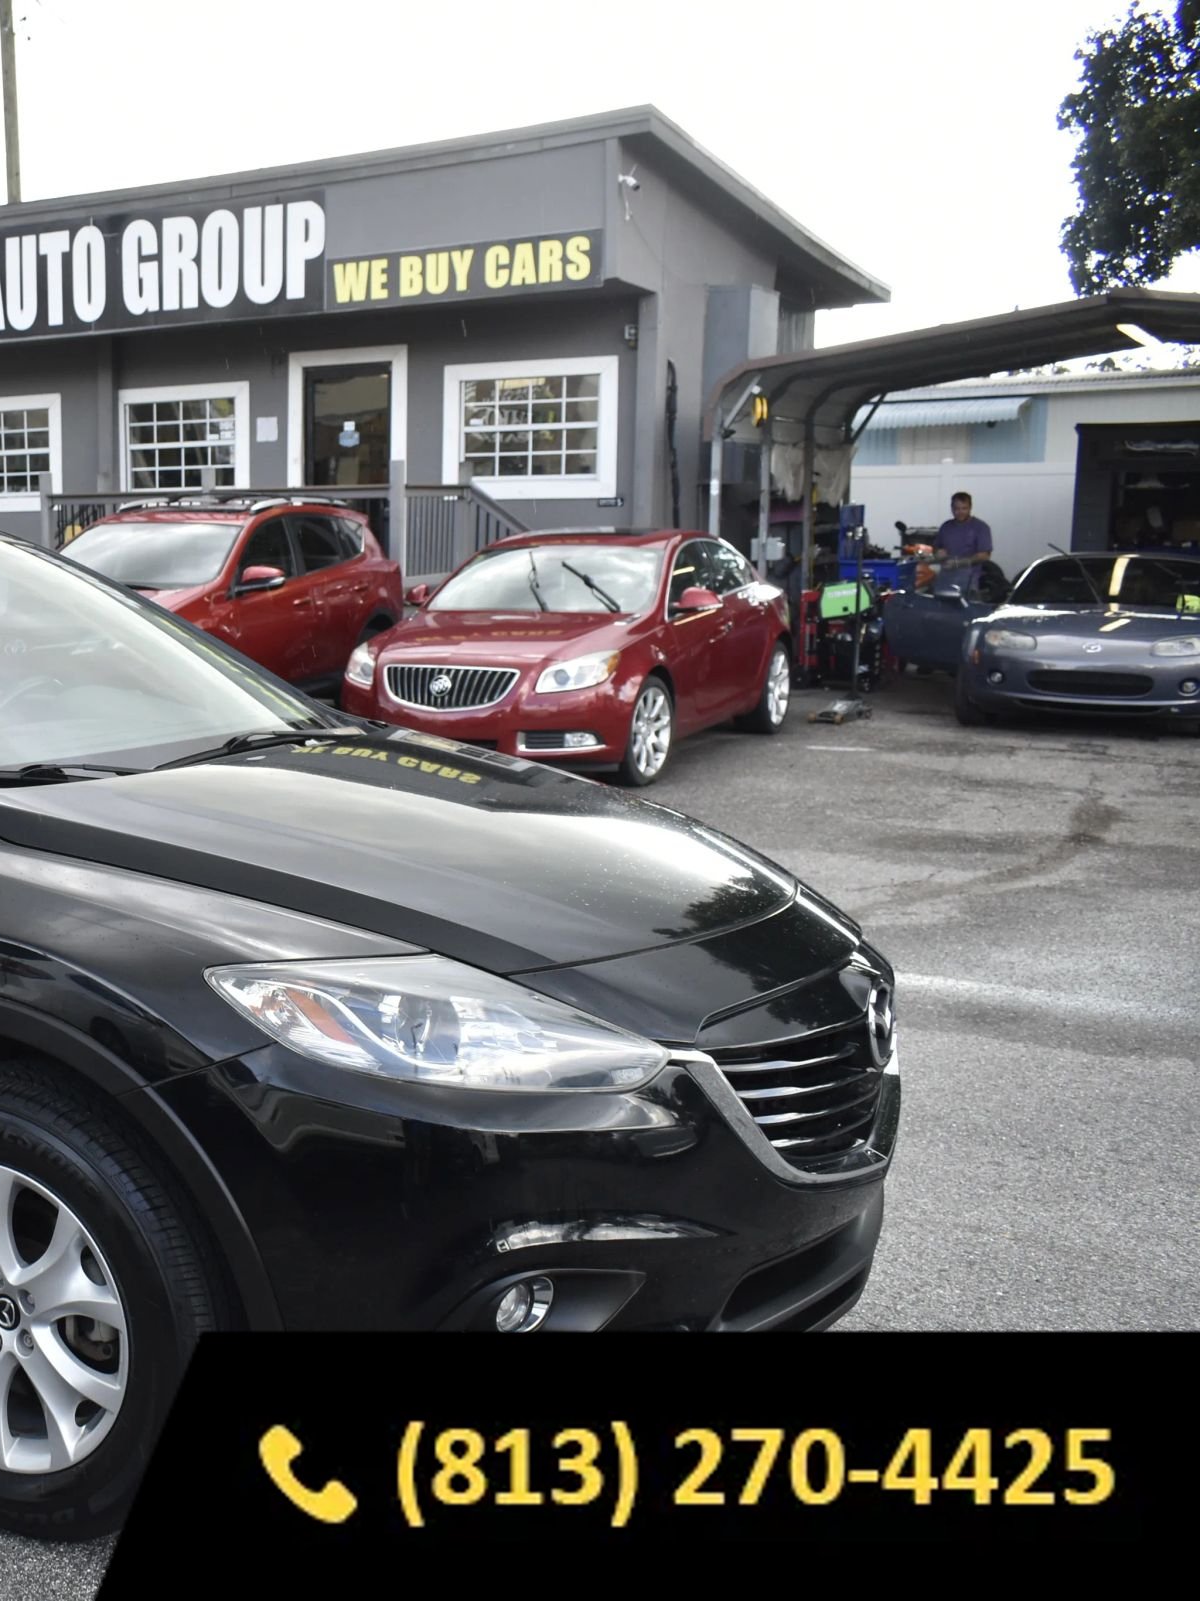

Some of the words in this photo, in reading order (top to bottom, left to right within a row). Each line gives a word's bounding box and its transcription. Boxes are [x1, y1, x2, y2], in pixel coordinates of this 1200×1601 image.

[122, 200, 325, 315] GROUP
[334, 259, 388, 303] WE
[400, 249, 474, 297] BUY
[485, 236, 590, 289] CARS
